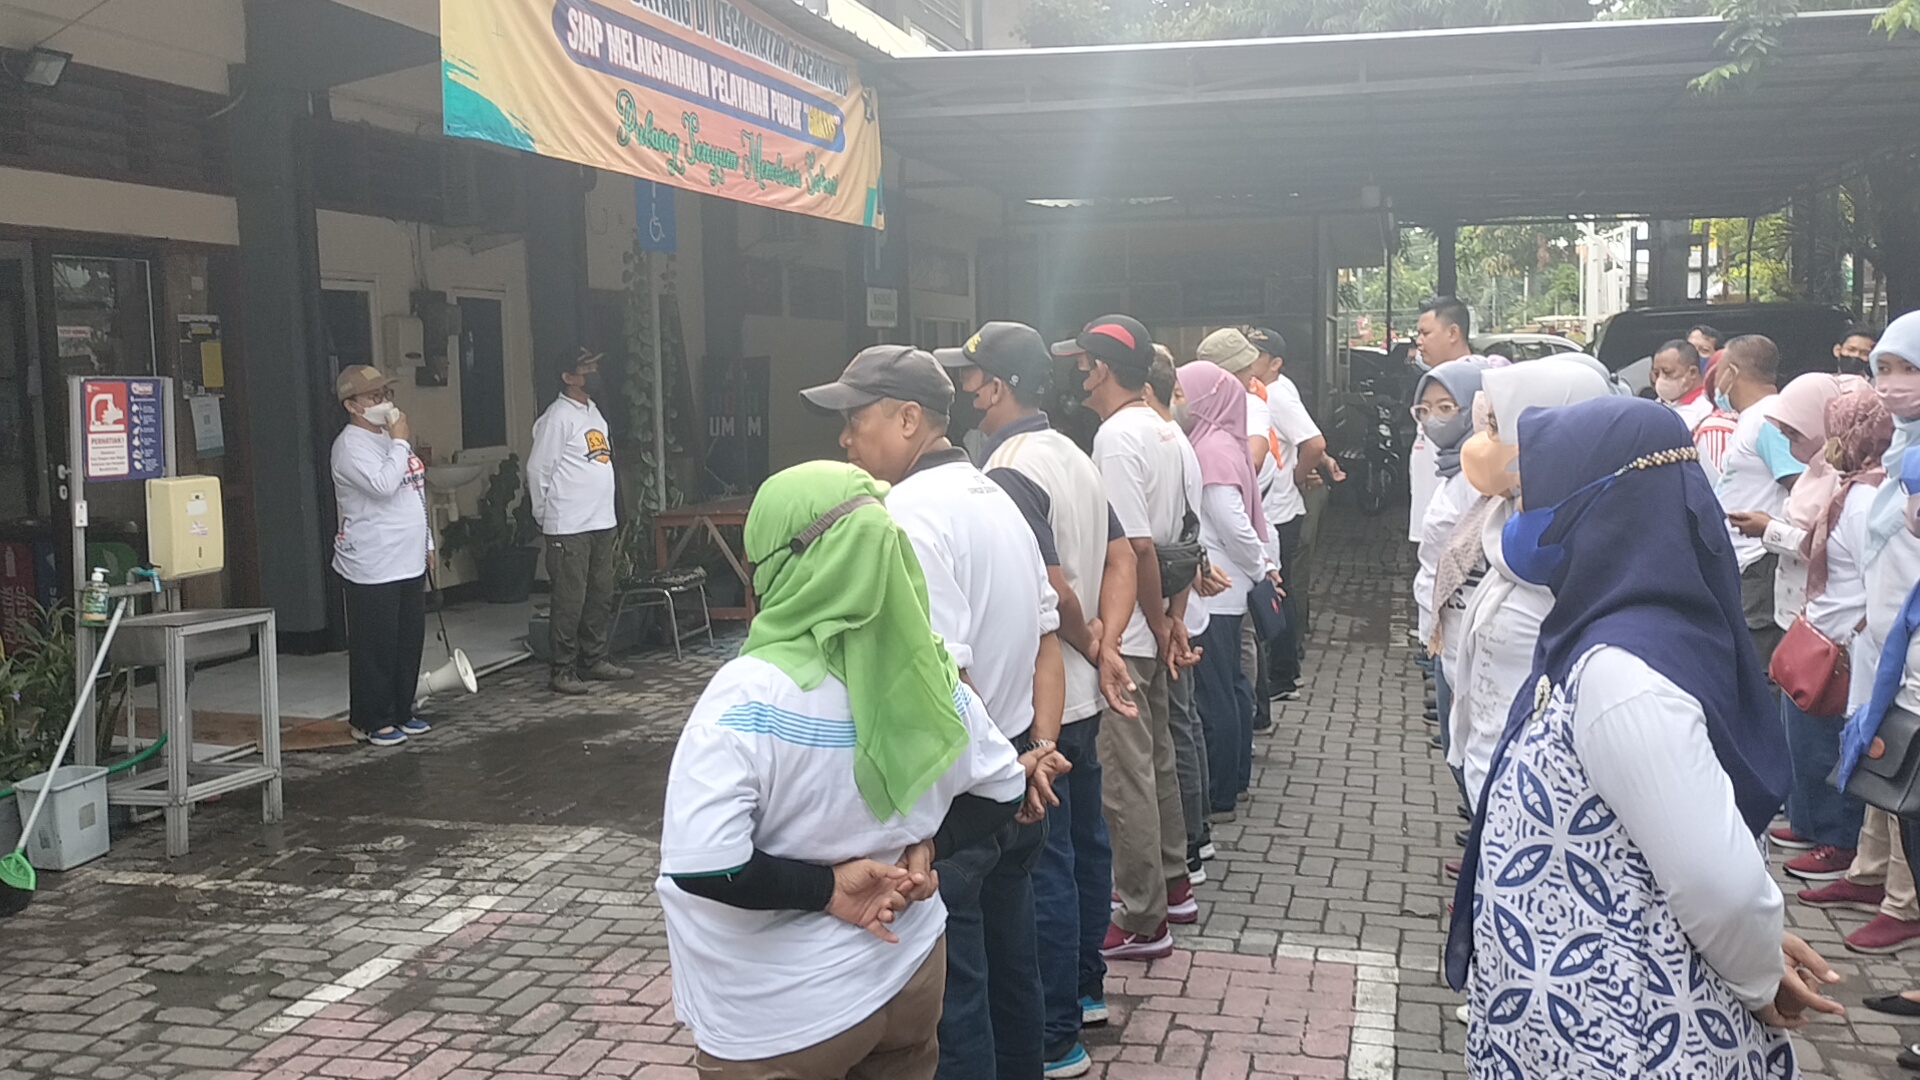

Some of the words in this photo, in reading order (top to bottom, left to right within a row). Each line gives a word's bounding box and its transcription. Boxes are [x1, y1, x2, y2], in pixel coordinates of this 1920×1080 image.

[567, 7, 603, 58] SIAP
[605, 22, 709, 97] MELAKSANAKAN
[710, 65, 769, 119] PELAYANAN
[770, 89, 801, 132] PUBLIK
[616, 88, 685, 176] Pulang
